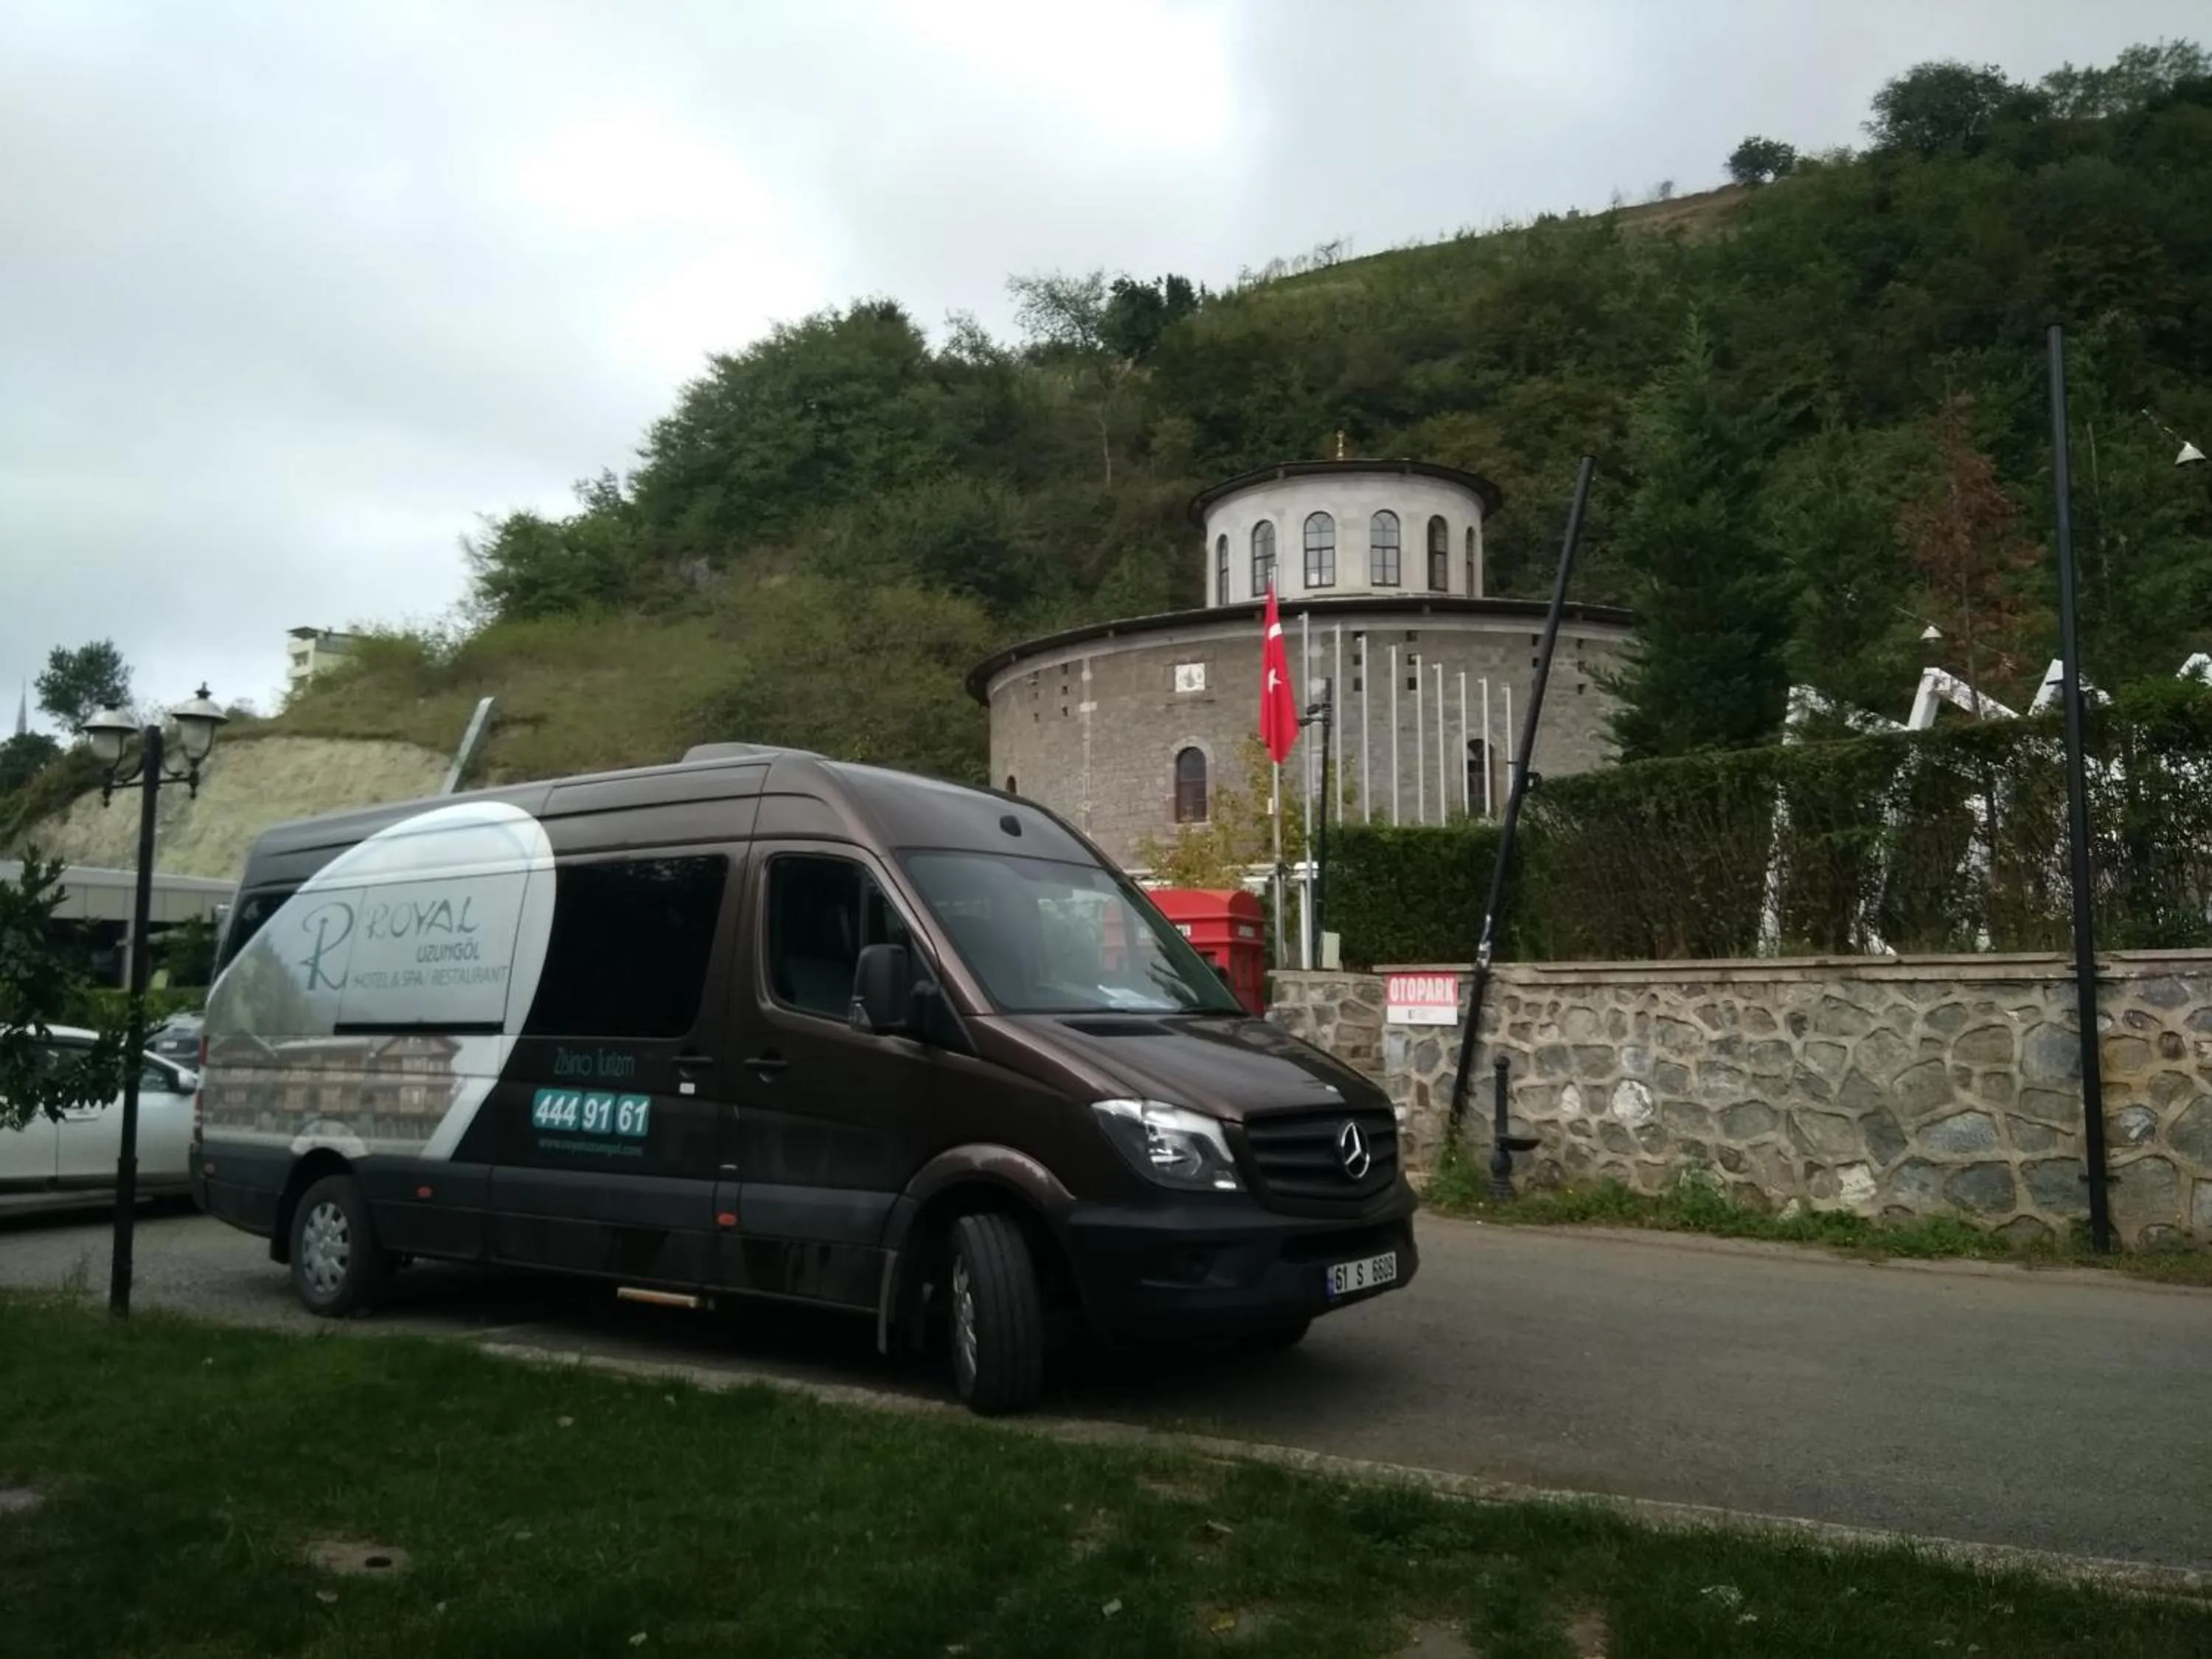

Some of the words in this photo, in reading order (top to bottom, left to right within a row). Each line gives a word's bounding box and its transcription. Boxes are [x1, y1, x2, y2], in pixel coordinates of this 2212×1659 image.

[366, 897, 479, 939] ROYAL
[417, 938, 479, 963] UZUNGÖL
[432, 965, 508, 986] RESTAURANT
[1389, 977, 1454, 1004] OTOPARK
[535, 1094, 578, 1127] 444
[582, 1097, 612, 1130] 91
[618, 1099, 648, 1133] 61
[1335, 1266, 1348, 1290] 61
[1356, 1262, 1363, 1286] S
